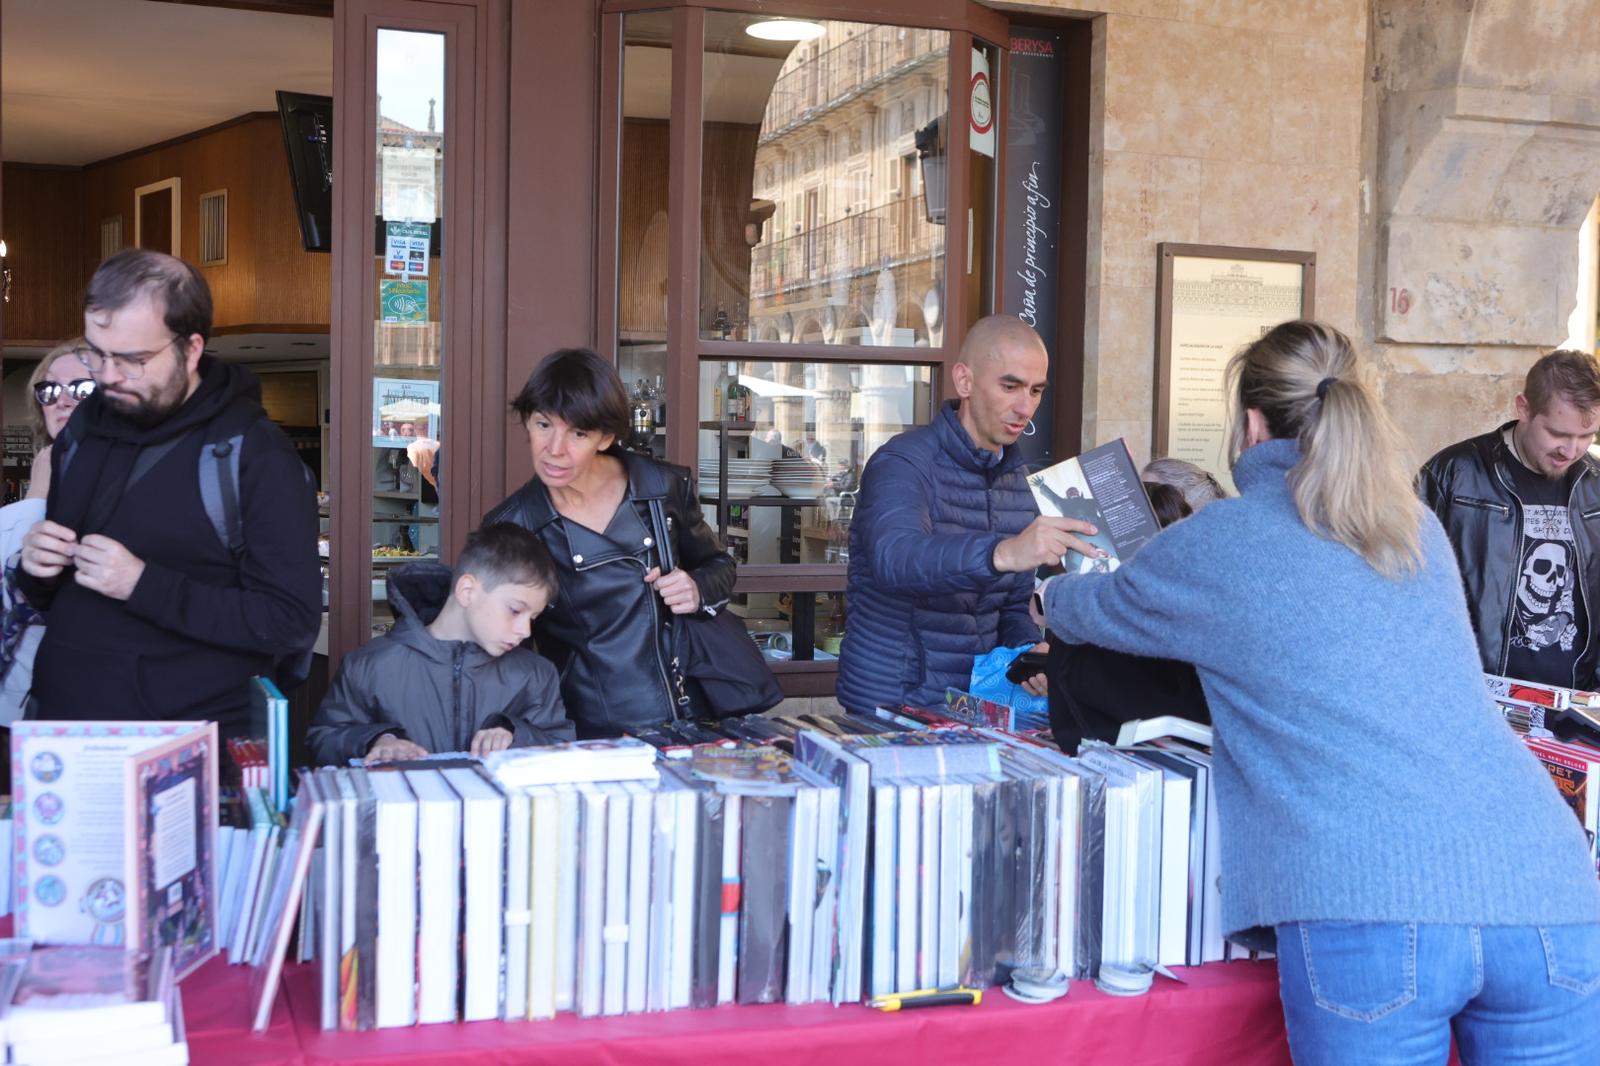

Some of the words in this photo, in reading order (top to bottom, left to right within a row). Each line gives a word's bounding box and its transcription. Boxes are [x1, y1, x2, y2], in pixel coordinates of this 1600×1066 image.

[1009, 37, 1053, 53] BERYSA
[1023, 207, 1047, 278] principio
[1017, 270, 1037, 289] de
[1018, 288, 1037, 328] Caña
[1390, 287, 1410, 315] 16
